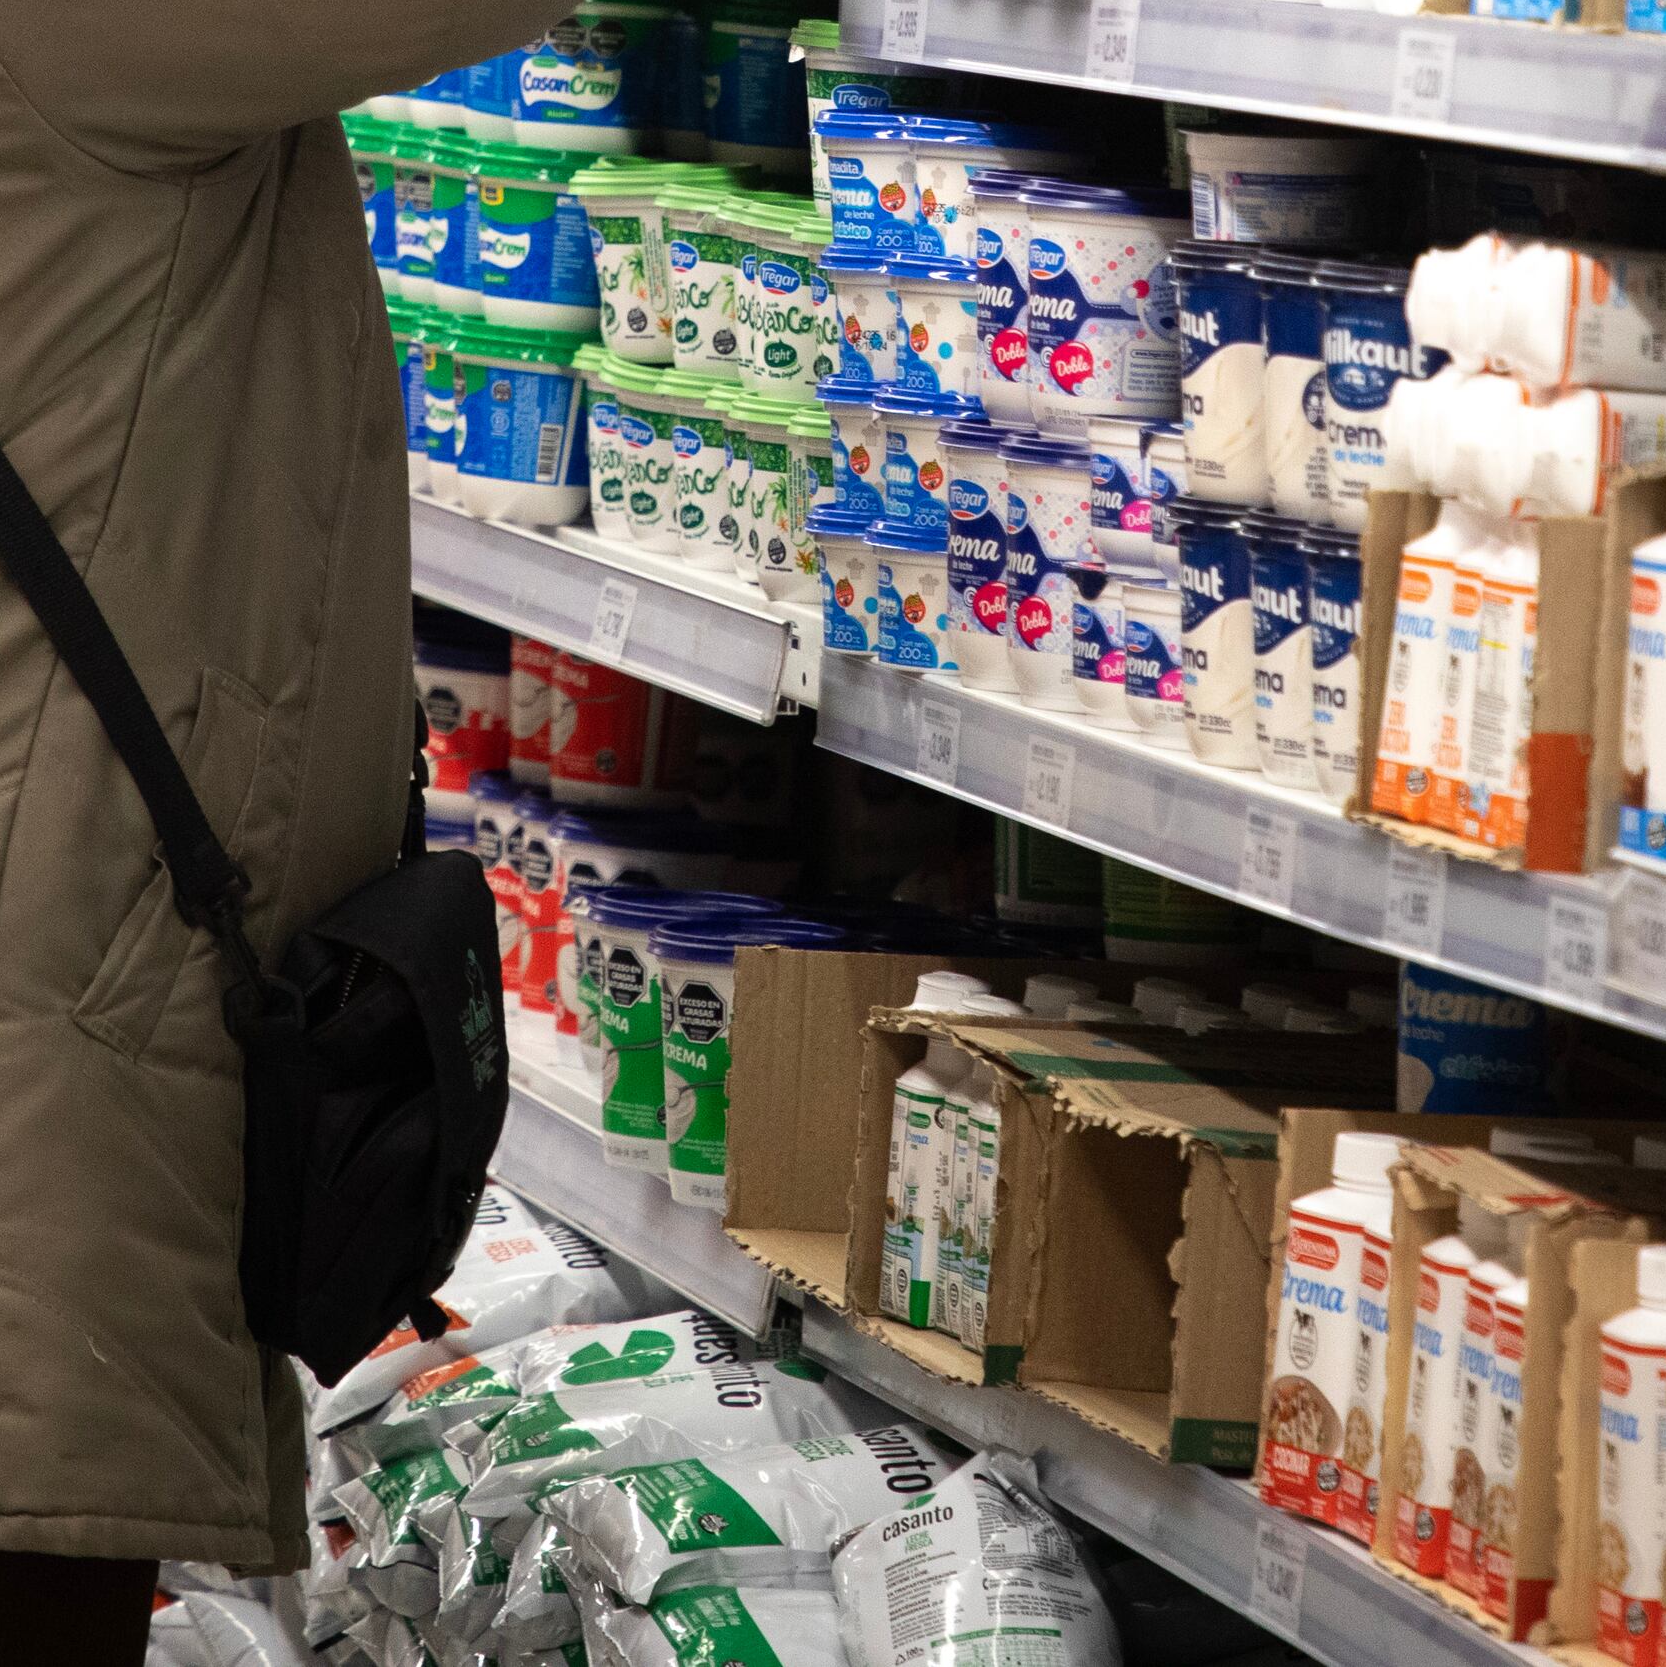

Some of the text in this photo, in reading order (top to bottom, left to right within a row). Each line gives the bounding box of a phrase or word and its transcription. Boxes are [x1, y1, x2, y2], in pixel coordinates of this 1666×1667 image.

[760, 267, 800, 290] Tregar
[767, 347, 794, 363] Light
[1326, 328, 1428, 379] ilkaut
[1055, 355, 1091, 378] Doble
[1329, 419, 1389, 450] crem
[1126, 510, 1152, 527] Dobl
[978, 592, 1007, 617] Dobl
[1020, 606, 1049, 631] Doble
[854, 1427, 936, 1494] santo
[882, 1504, 954, 1543] casanto
